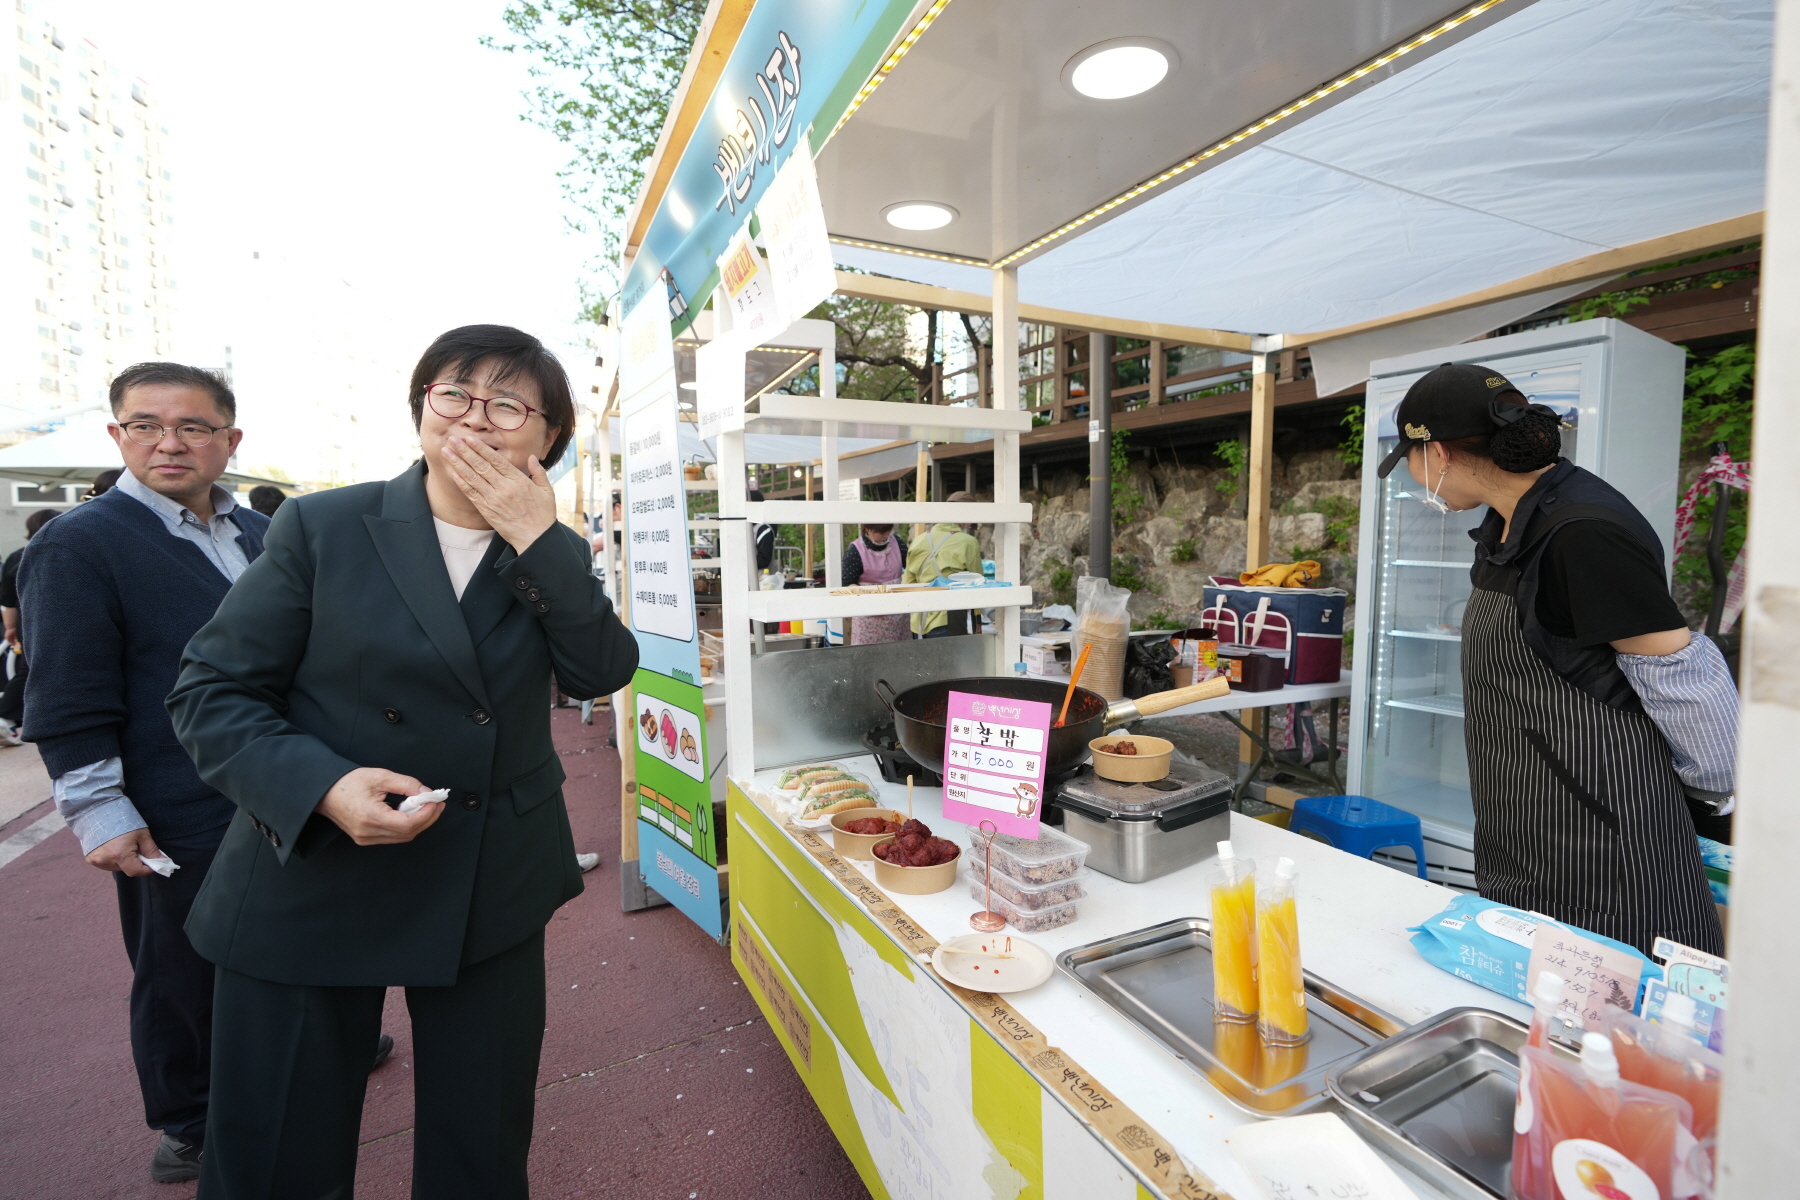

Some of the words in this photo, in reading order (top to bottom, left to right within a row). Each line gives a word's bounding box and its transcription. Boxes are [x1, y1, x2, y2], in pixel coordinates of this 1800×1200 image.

[655, 460, 673, 480] 2,000원
[657, 494, 675, 512] 2,000원
[651, 528, 670, 543] 6,000원
[634, 560, 647, 575] 탕후루
[649, 560, 668, 575] 4,000원
[635, 590, 656, 606] 수제미트볼
[658, 592, 678, 608] 5,000원
[1025, 760, 1035, 772] 원
[948, 788, 966, 800] 원산지
[1477, 956, 1505, 976] 물티슈
